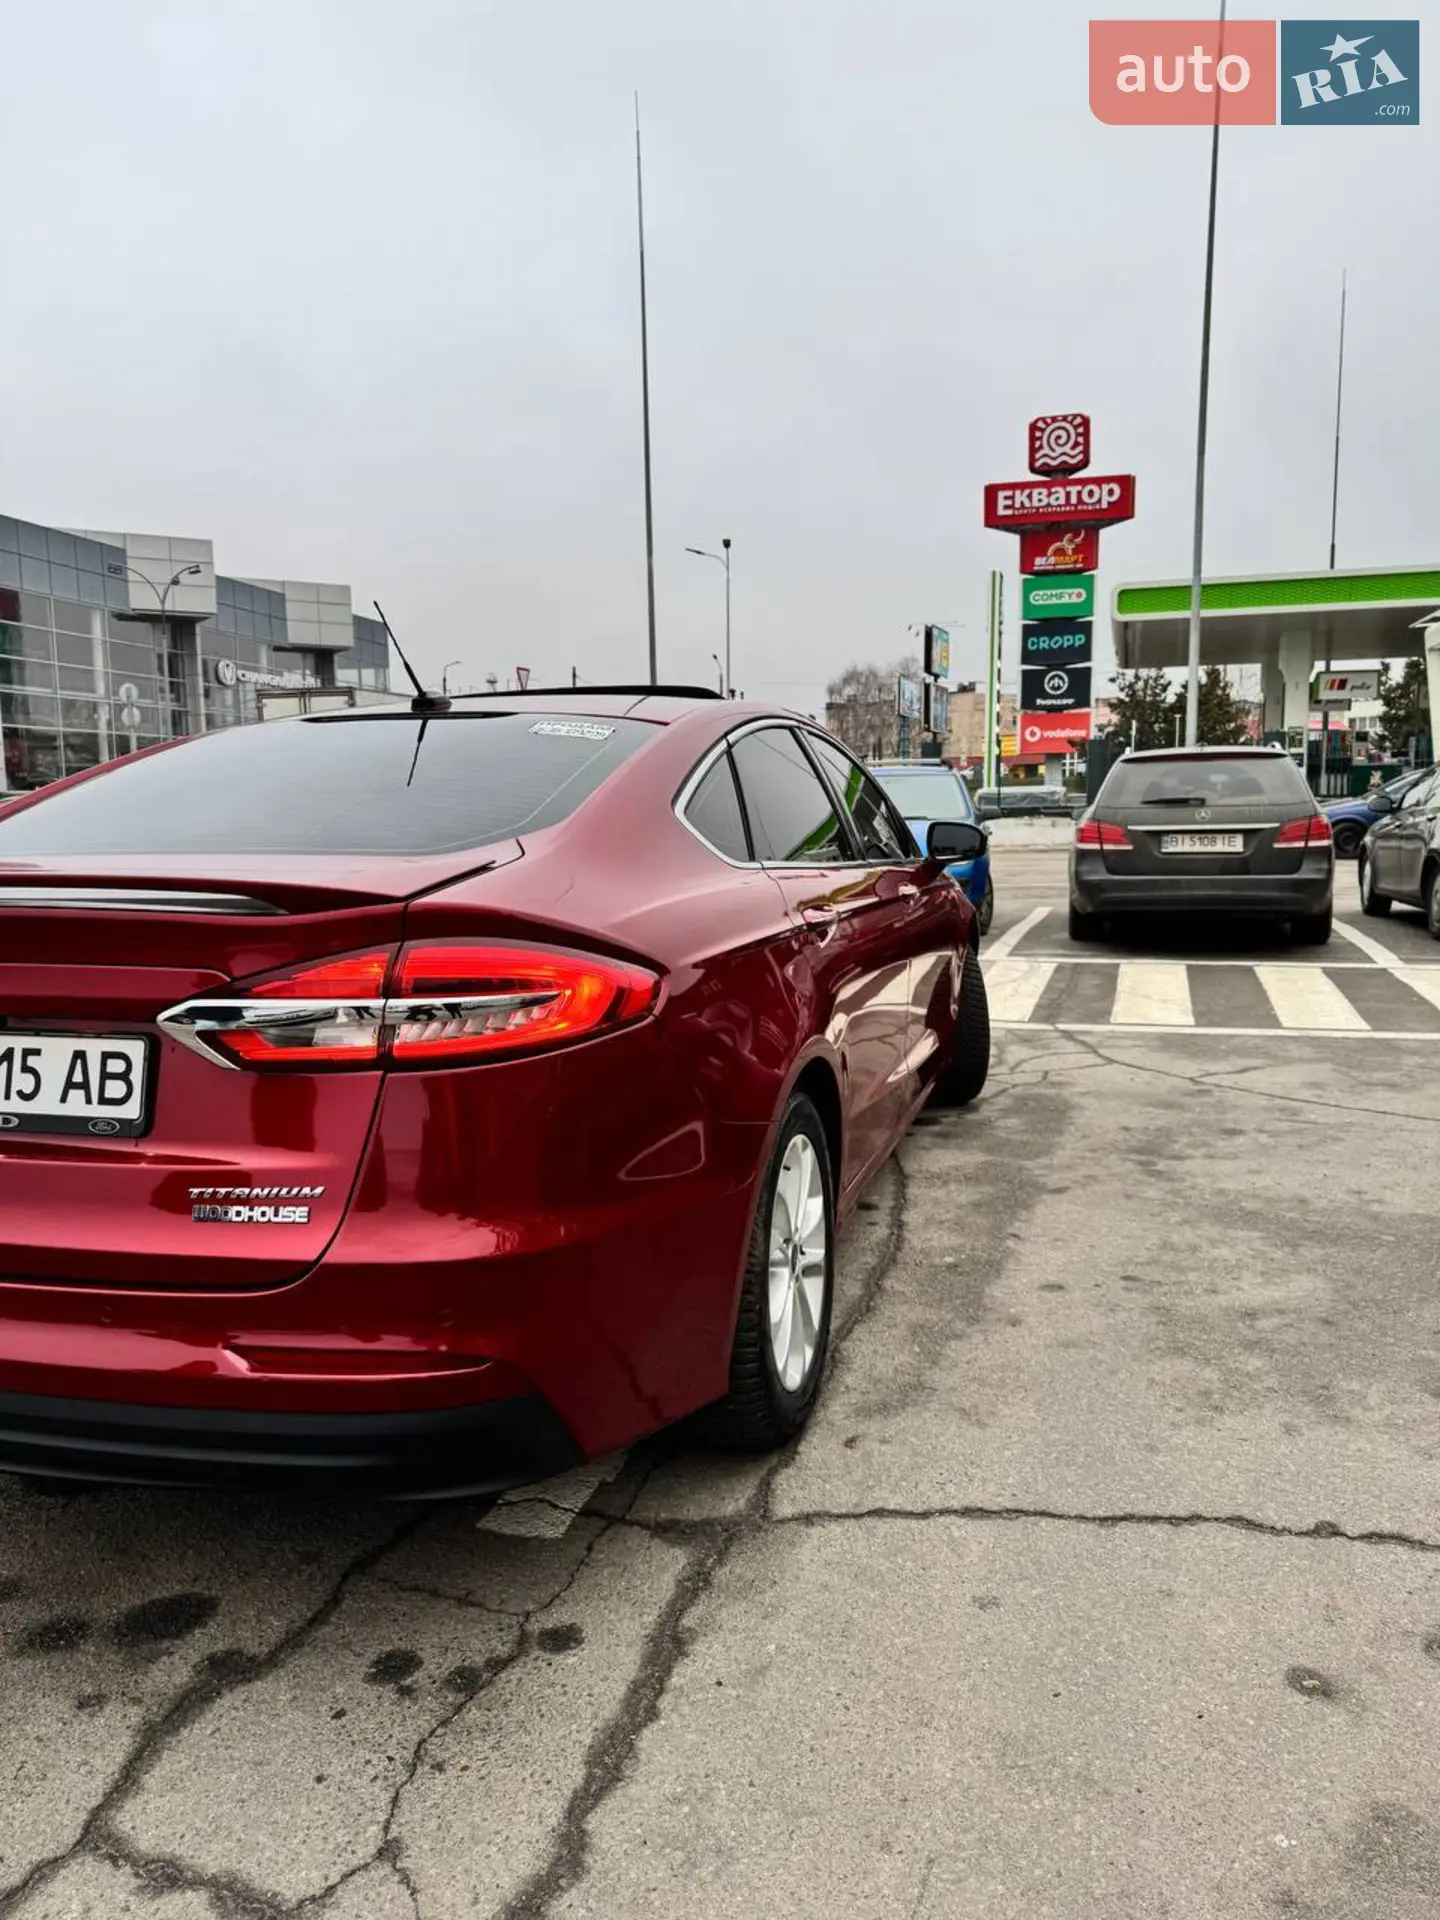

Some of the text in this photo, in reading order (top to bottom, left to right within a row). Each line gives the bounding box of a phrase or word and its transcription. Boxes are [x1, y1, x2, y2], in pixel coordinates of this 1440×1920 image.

[996, 482, 1121, 516] Екватор
[1032, 590, 1074, 603] COMFY
[1042, 728, 1087, 738] vodafone
[1169, 835, 1238, 847] BI 5108 IE
[59, 1049, 134, 1106] AB
[188, 1185, 325, 1200] TITANIUM
[192, 1205, 310, 1223] WOODHOUSE
